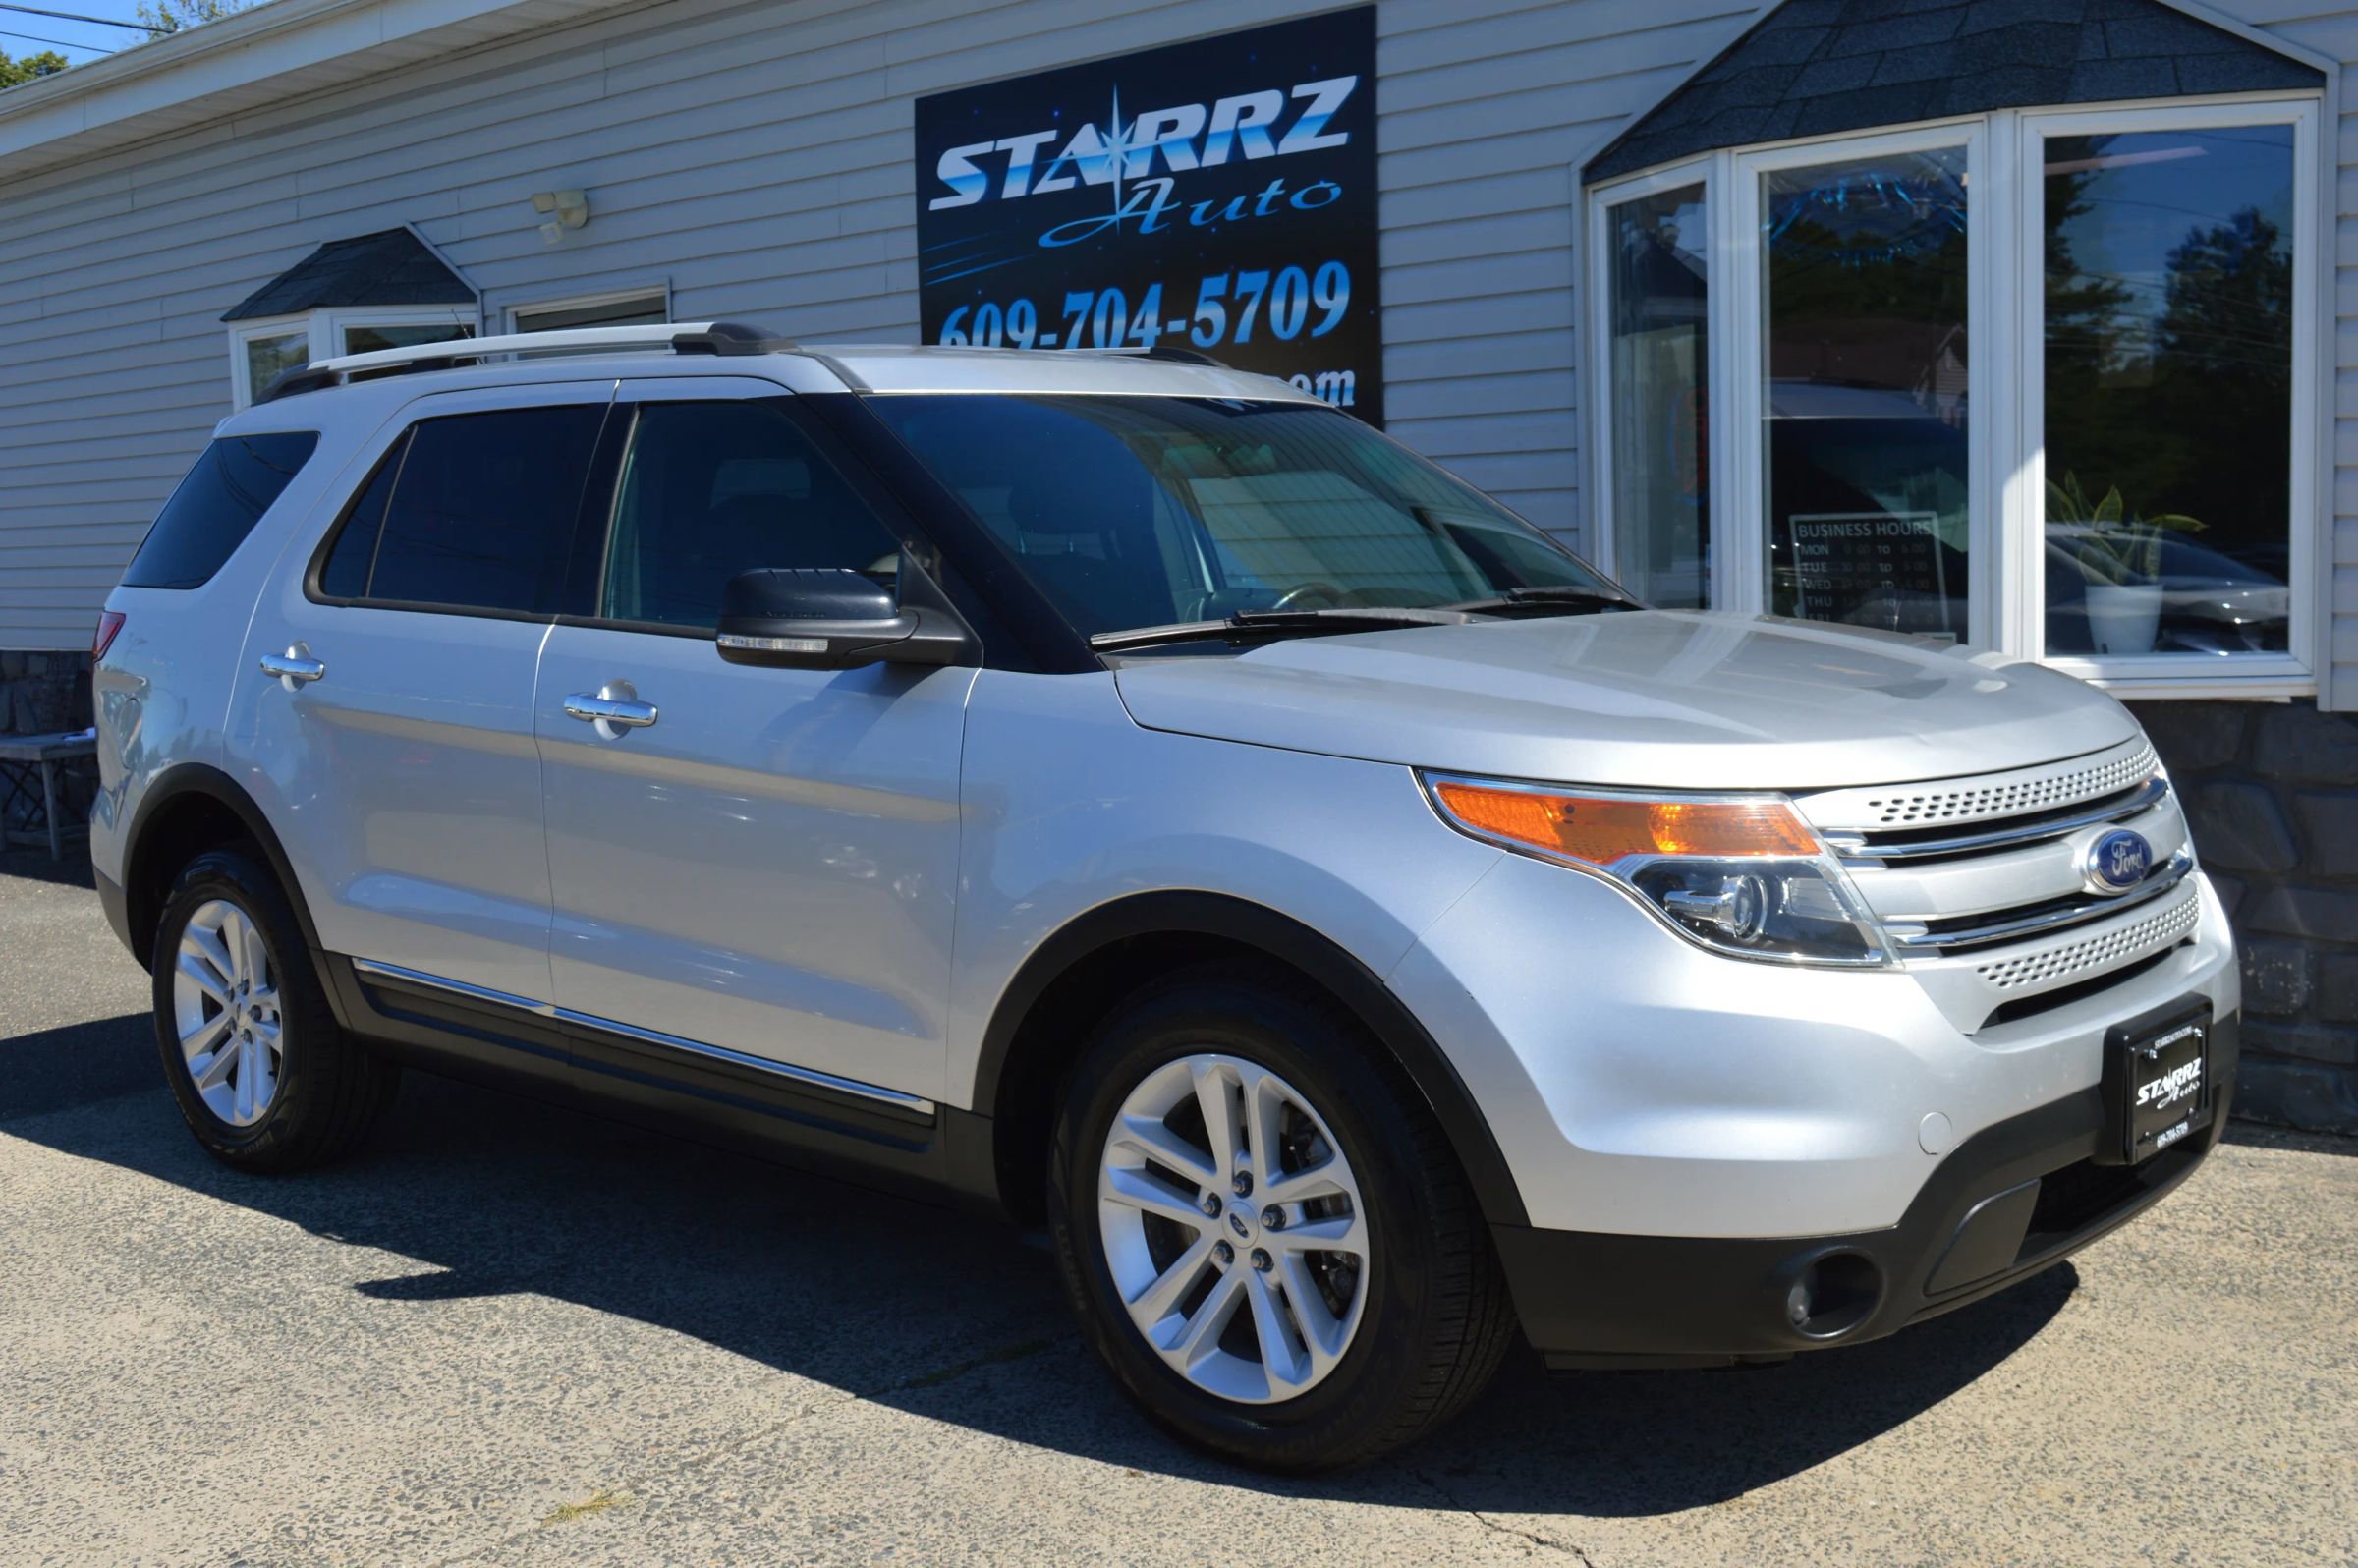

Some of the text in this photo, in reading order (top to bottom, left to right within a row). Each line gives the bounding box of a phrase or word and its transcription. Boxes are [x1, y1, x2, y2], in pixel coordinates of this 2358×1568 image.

[928, 75, 1358, 211] STARRZ
[1038, 176, 1343, 249] Auto
[938, 260, 1351, 350] 609-704-5709
[1798, 521, 1931, 538] BUSINESS HOURS
[1800, 545, 1830, 556] MON
[1877, 545, 1891, 555] TO
[1802, 562, 1828, 573] TUE
[1804, 579, 1832, 590] WED
[1807, 596, 1832, 607] THU
[2111, 838, 2144, 876] Ford
[2136, 1057, 2202, 1106] STARRZ
[2157, 1080, 2201, 1110] Auto
